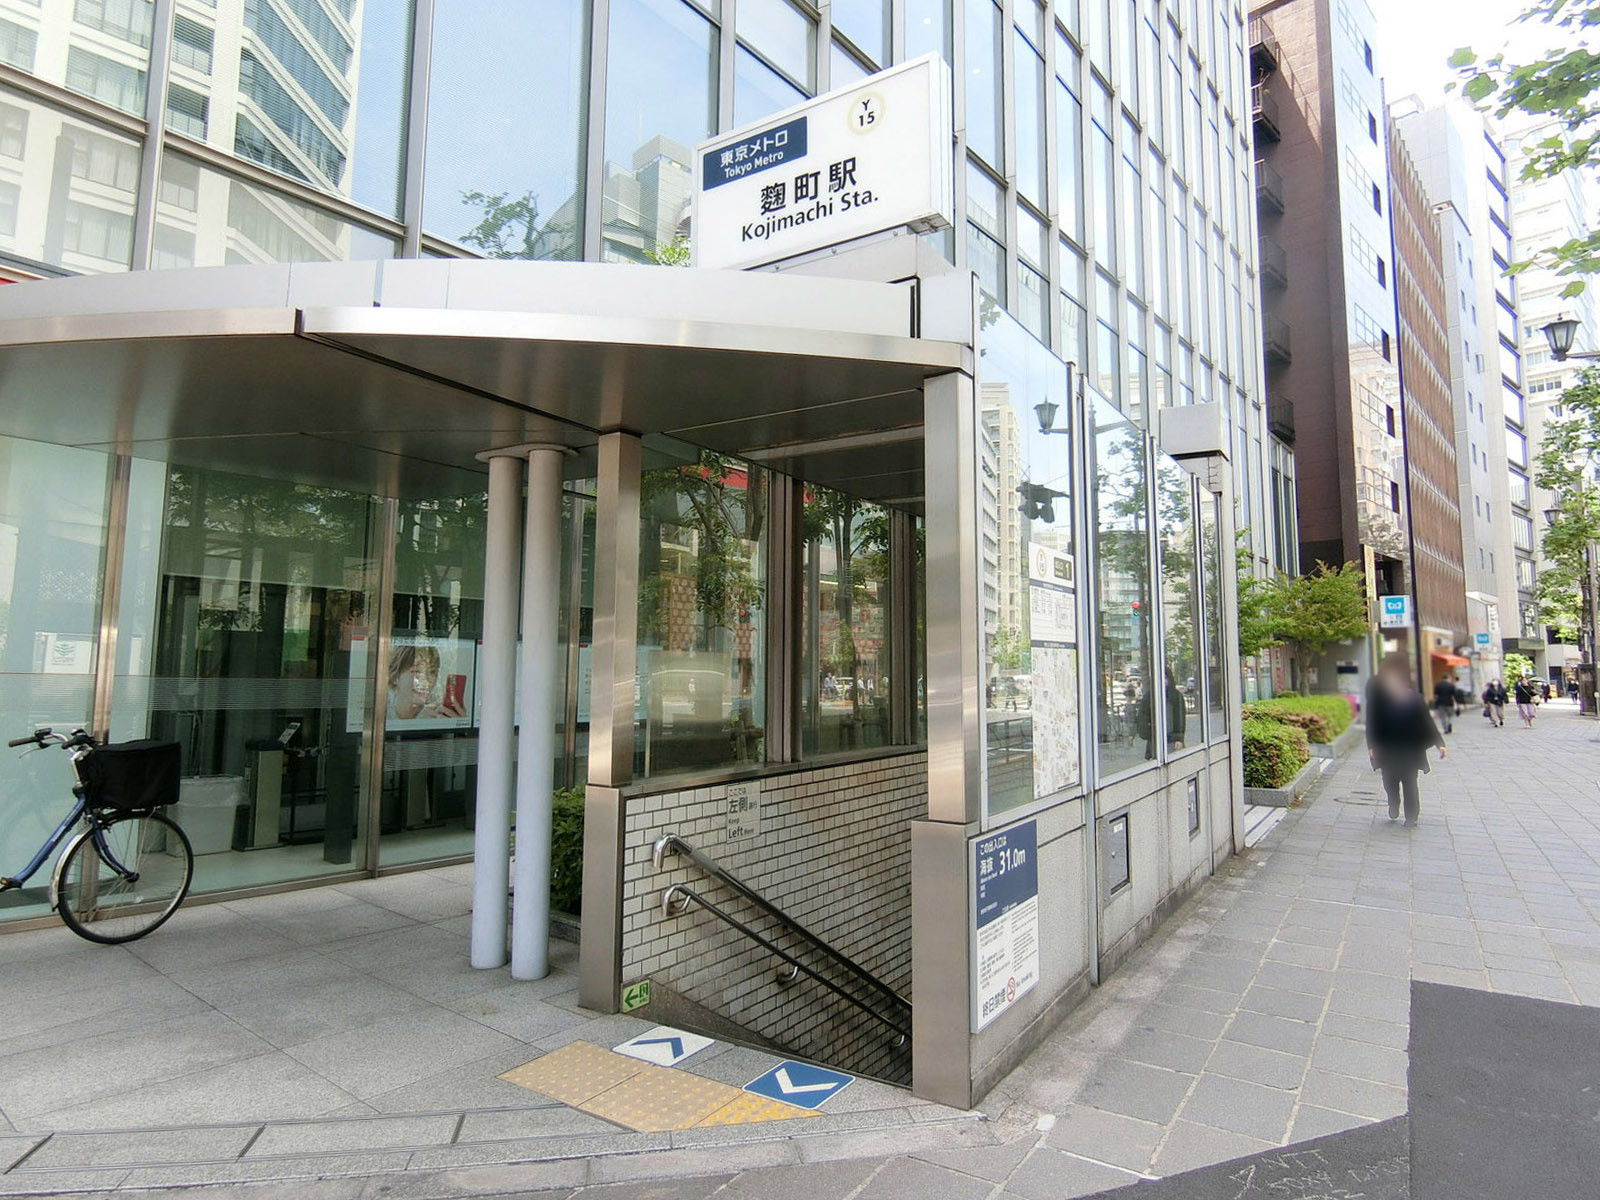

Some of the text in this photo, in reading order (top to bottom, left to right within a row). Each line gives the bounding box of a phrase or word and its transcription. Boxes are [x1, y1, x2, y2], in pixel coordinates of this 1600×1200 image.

[862, 99, 871, 111] Y
[858, 111, 876, 127] 15
[720, 129, 789, 168] 東京メトロ
[724, 151, 784, 179] Tokyo Metro
[741, 188, 879, 242] Kojimachi Sta.
[728, 826, 743, 839] Left
[979, 835, 1007, 855] この出入口は
[999, 848, 1026, 875] 31.0m
